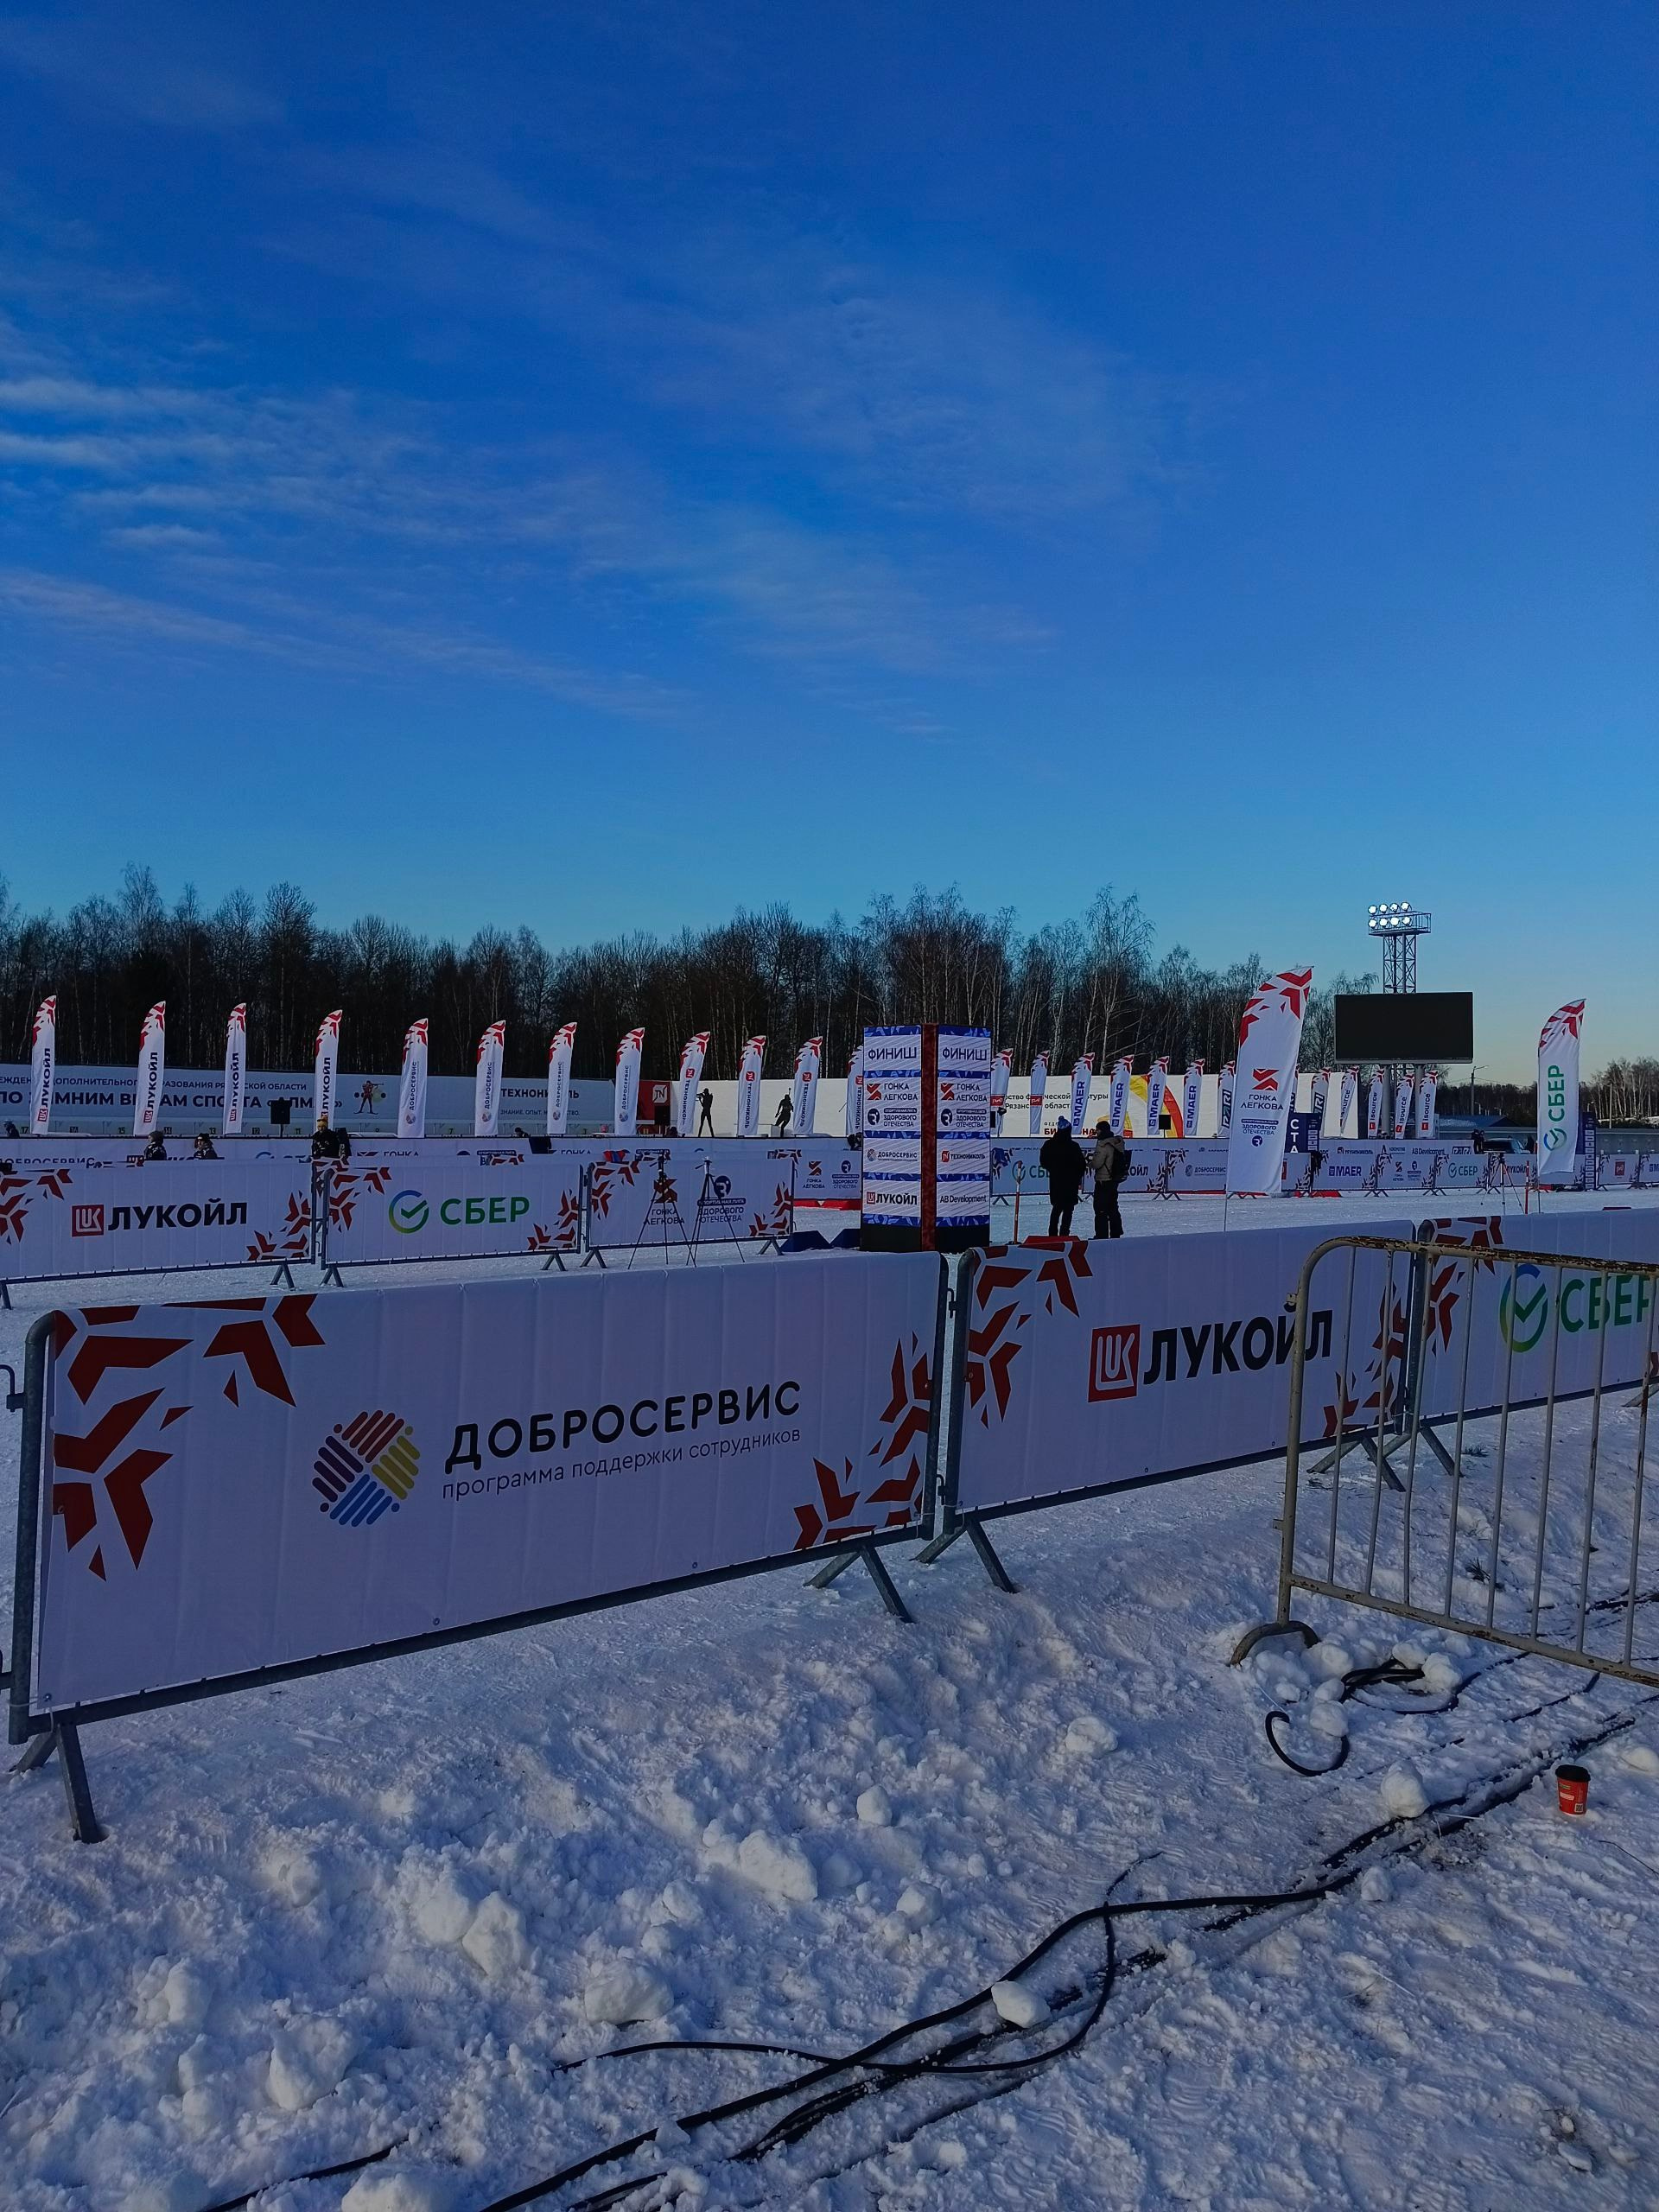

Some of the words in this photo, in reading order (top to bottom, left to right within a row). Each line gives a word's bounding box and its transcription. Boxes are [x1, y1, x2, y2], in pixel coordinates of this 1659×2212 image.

[868, 1046, 917, 1060] ФИНИШ
[942, 1047, 987, 1061] ФИНИШ
[41, 1048, 51, 1107] ЛУКОЙЛ
[54, 1077, 137, 1086] ОПОЛНИТЕЛЬНОГ
[147, 1052, 158, 1109] ЛУКОЙЛ
[230, 1052, 239, 1107] ЛУКОЙЛ
[322, 1057, 331, 1109] ЛУКОЙЛ
[501, 1088, 580, 1099] ТЕХНОНЬ
[957, 1083, 981, 1091] ГОНКА
[1548, 1065, 1565, 1122] СБЕР
[193, 1095, 262, 1108] СПТА
[1074, 1081, 1085, 1115] MAER
[1113, 1082, 1124, 1118] MAER
[1149, 1084, 1160, 1118] MAER
[1186, 1085, 1197, 1119] MAER
[1240, 1102, 1284, 1110] ЛЕГКОВА
[1336, 1166, 1362, 1176] MAER
[1458, 1166, 1478, 1176] СБЕР
[107, 1198, 247, 1231] ЛУКОЙЛ
[440, 1197, 530, 1225] СБЕР
[875, 1193, 918, 1205] ЛУКОЙЛ
[949, 1195, 987, 1205] Development
[1142, 1301, 1333, 1385] ЛУКОЙЛ
[443, 1380, 801, 1475] ДОБРОСЕРВИС
[442, 1463, 565, 1501] программа
[571, 1447, 683, 1478] поддержки
[688, 1427, 801, 1463] сотрудников
